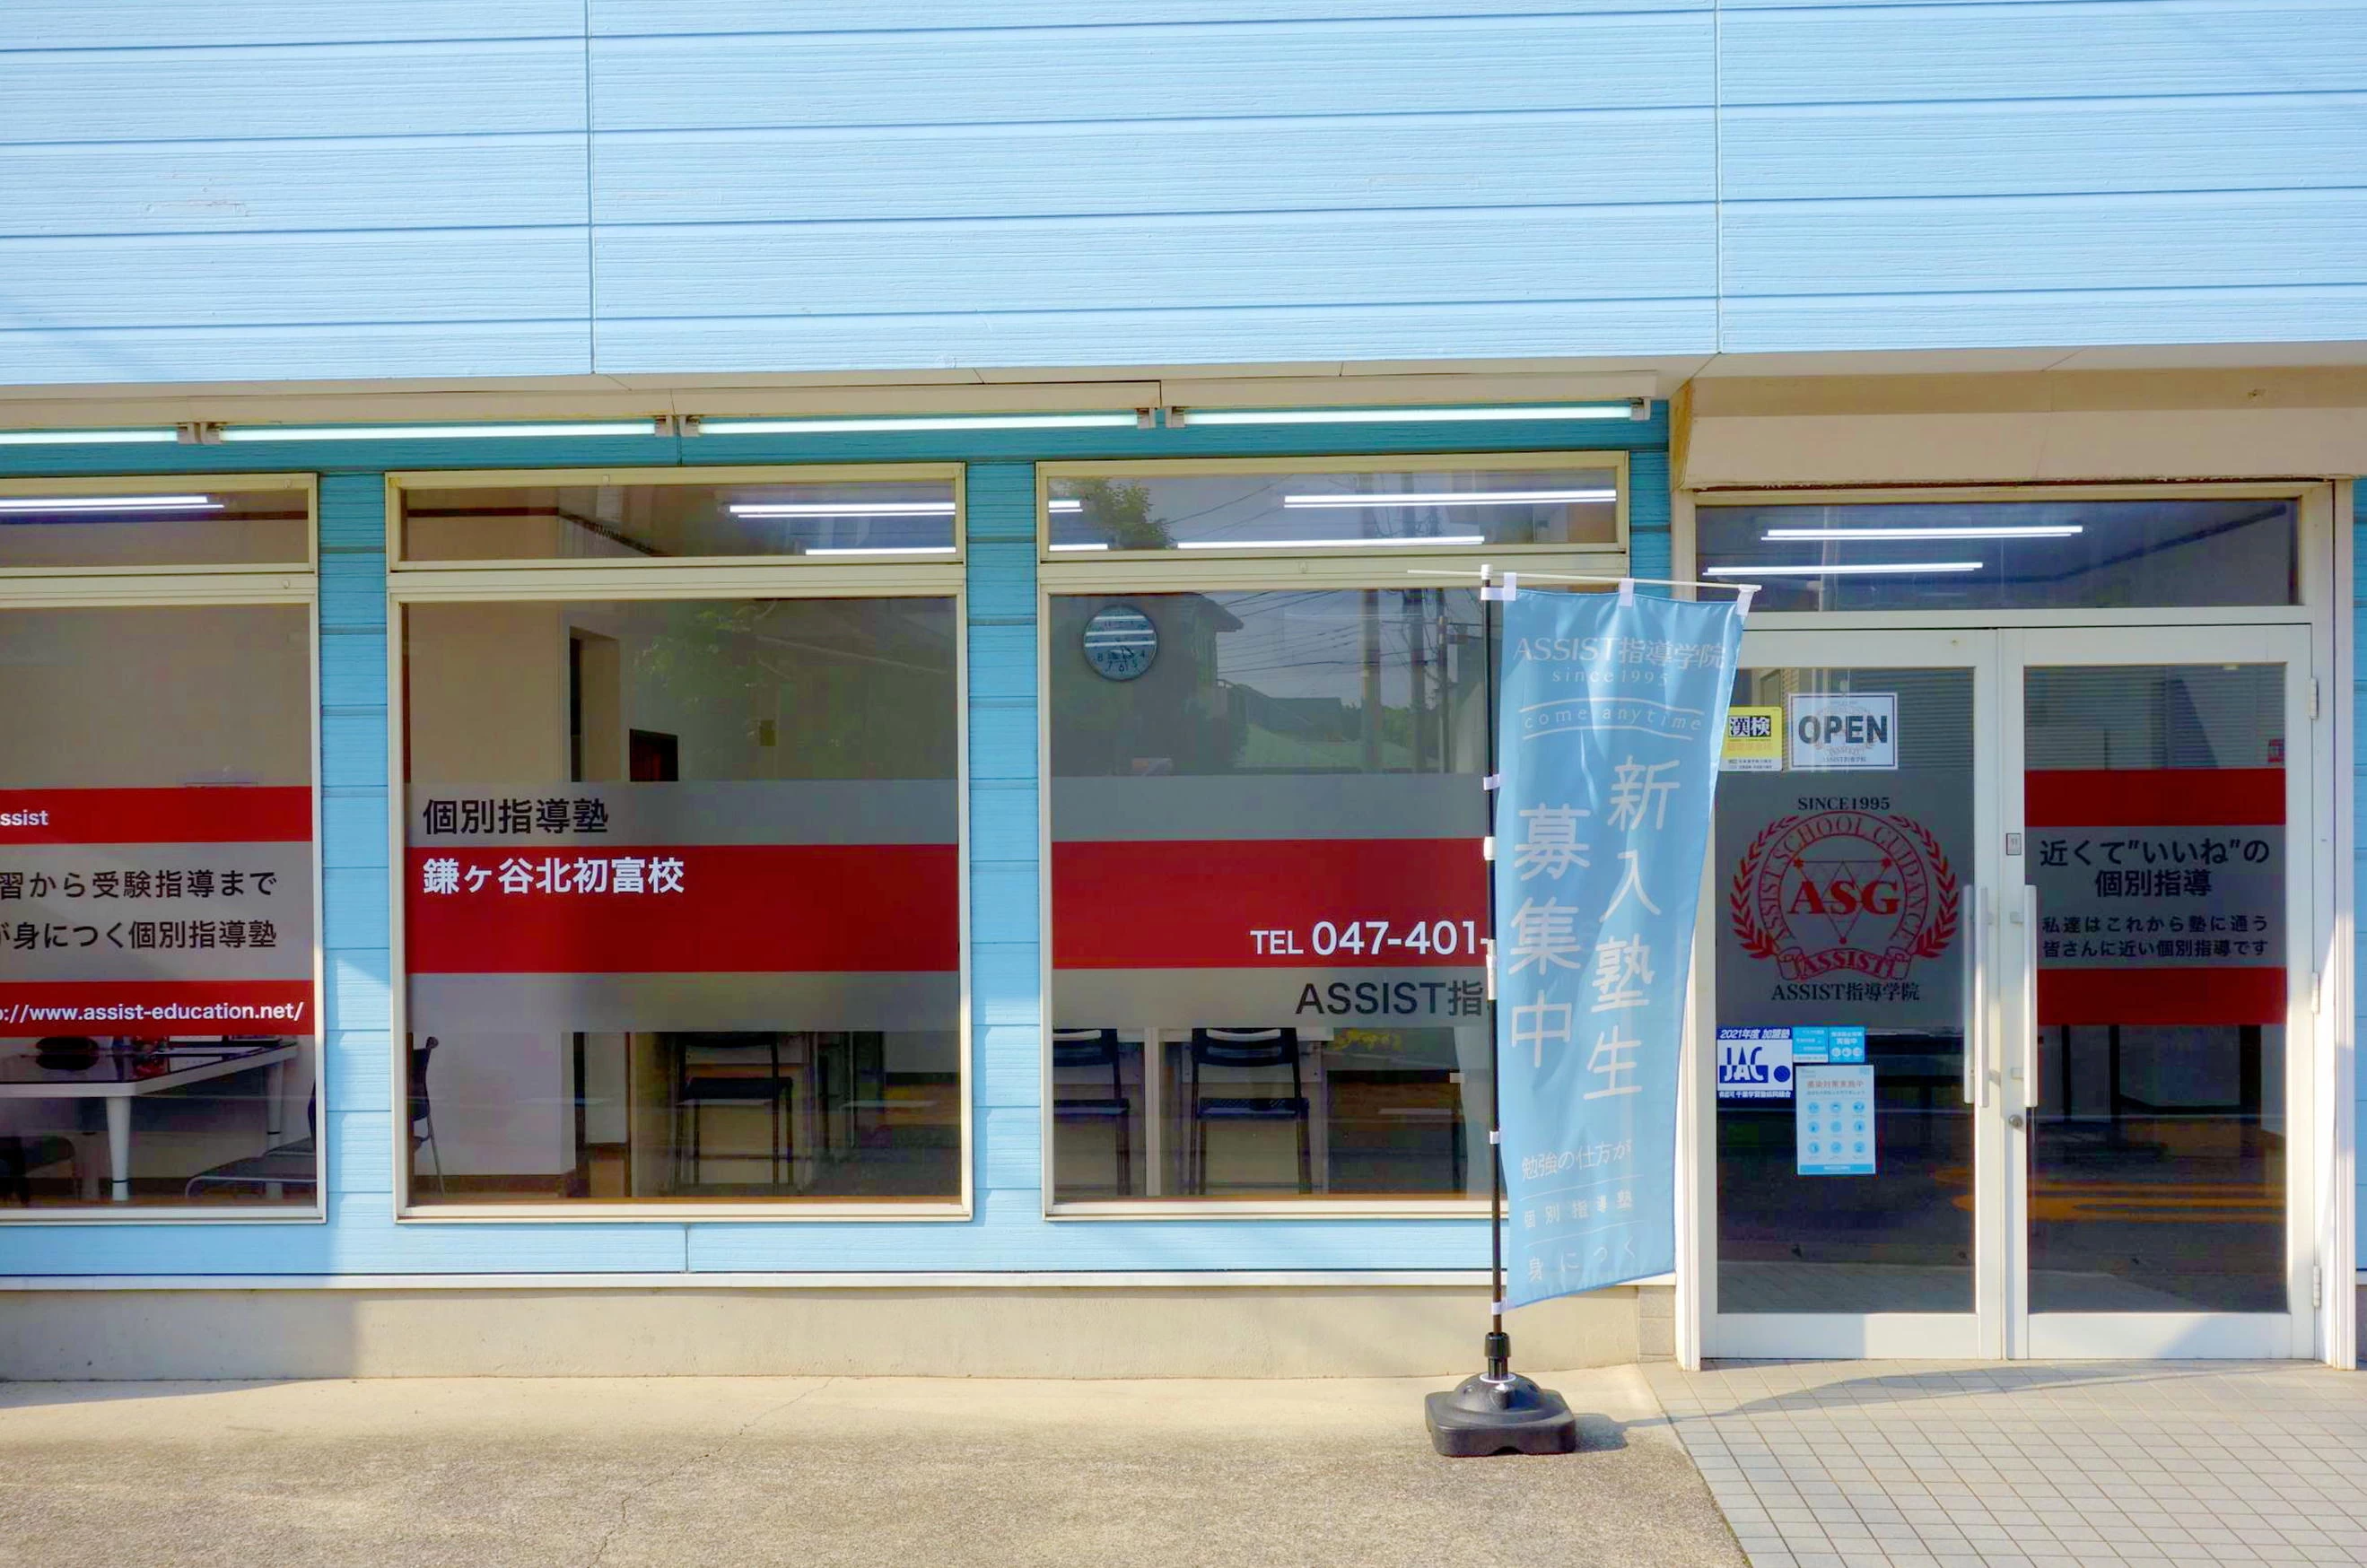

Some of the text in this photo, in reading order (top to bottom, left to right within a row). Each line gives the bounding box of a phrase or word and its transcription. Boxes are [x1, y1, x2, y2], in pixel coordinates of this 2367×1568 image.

[1524, 708, 1588, 729] come
[1798, 715, 1888, 745] OPEN
[423, 797, 609, 835] 個別指導塾
[1772, 814, 1865, 859] SCHOOL
[0, 868, 278, 900] 習から受験指導まで
[423, 856, 685, 895] 鎌ヶ谷北初富校
[2094, 868, 2213, 898] 個別指導
[1786, 880, 1902, 916] ASG
[1508, 803, 1592, 1068] 募集中
[1583, 754, 1681, 1101] 新入塾生
[2041, 914, 2268, 934] 私達はこれから塾に通う
[1250, 929, 1304, 954] TEL
[2041, 939, 2268, 958] 皆さんに近い個別指導です
[1771, 981, 1920, 1002] ASSIST指導学院
[1723, 1046, 1765, 1082] JAC
[1521, 1138, 1632, 1182] 勉強の仕方が
